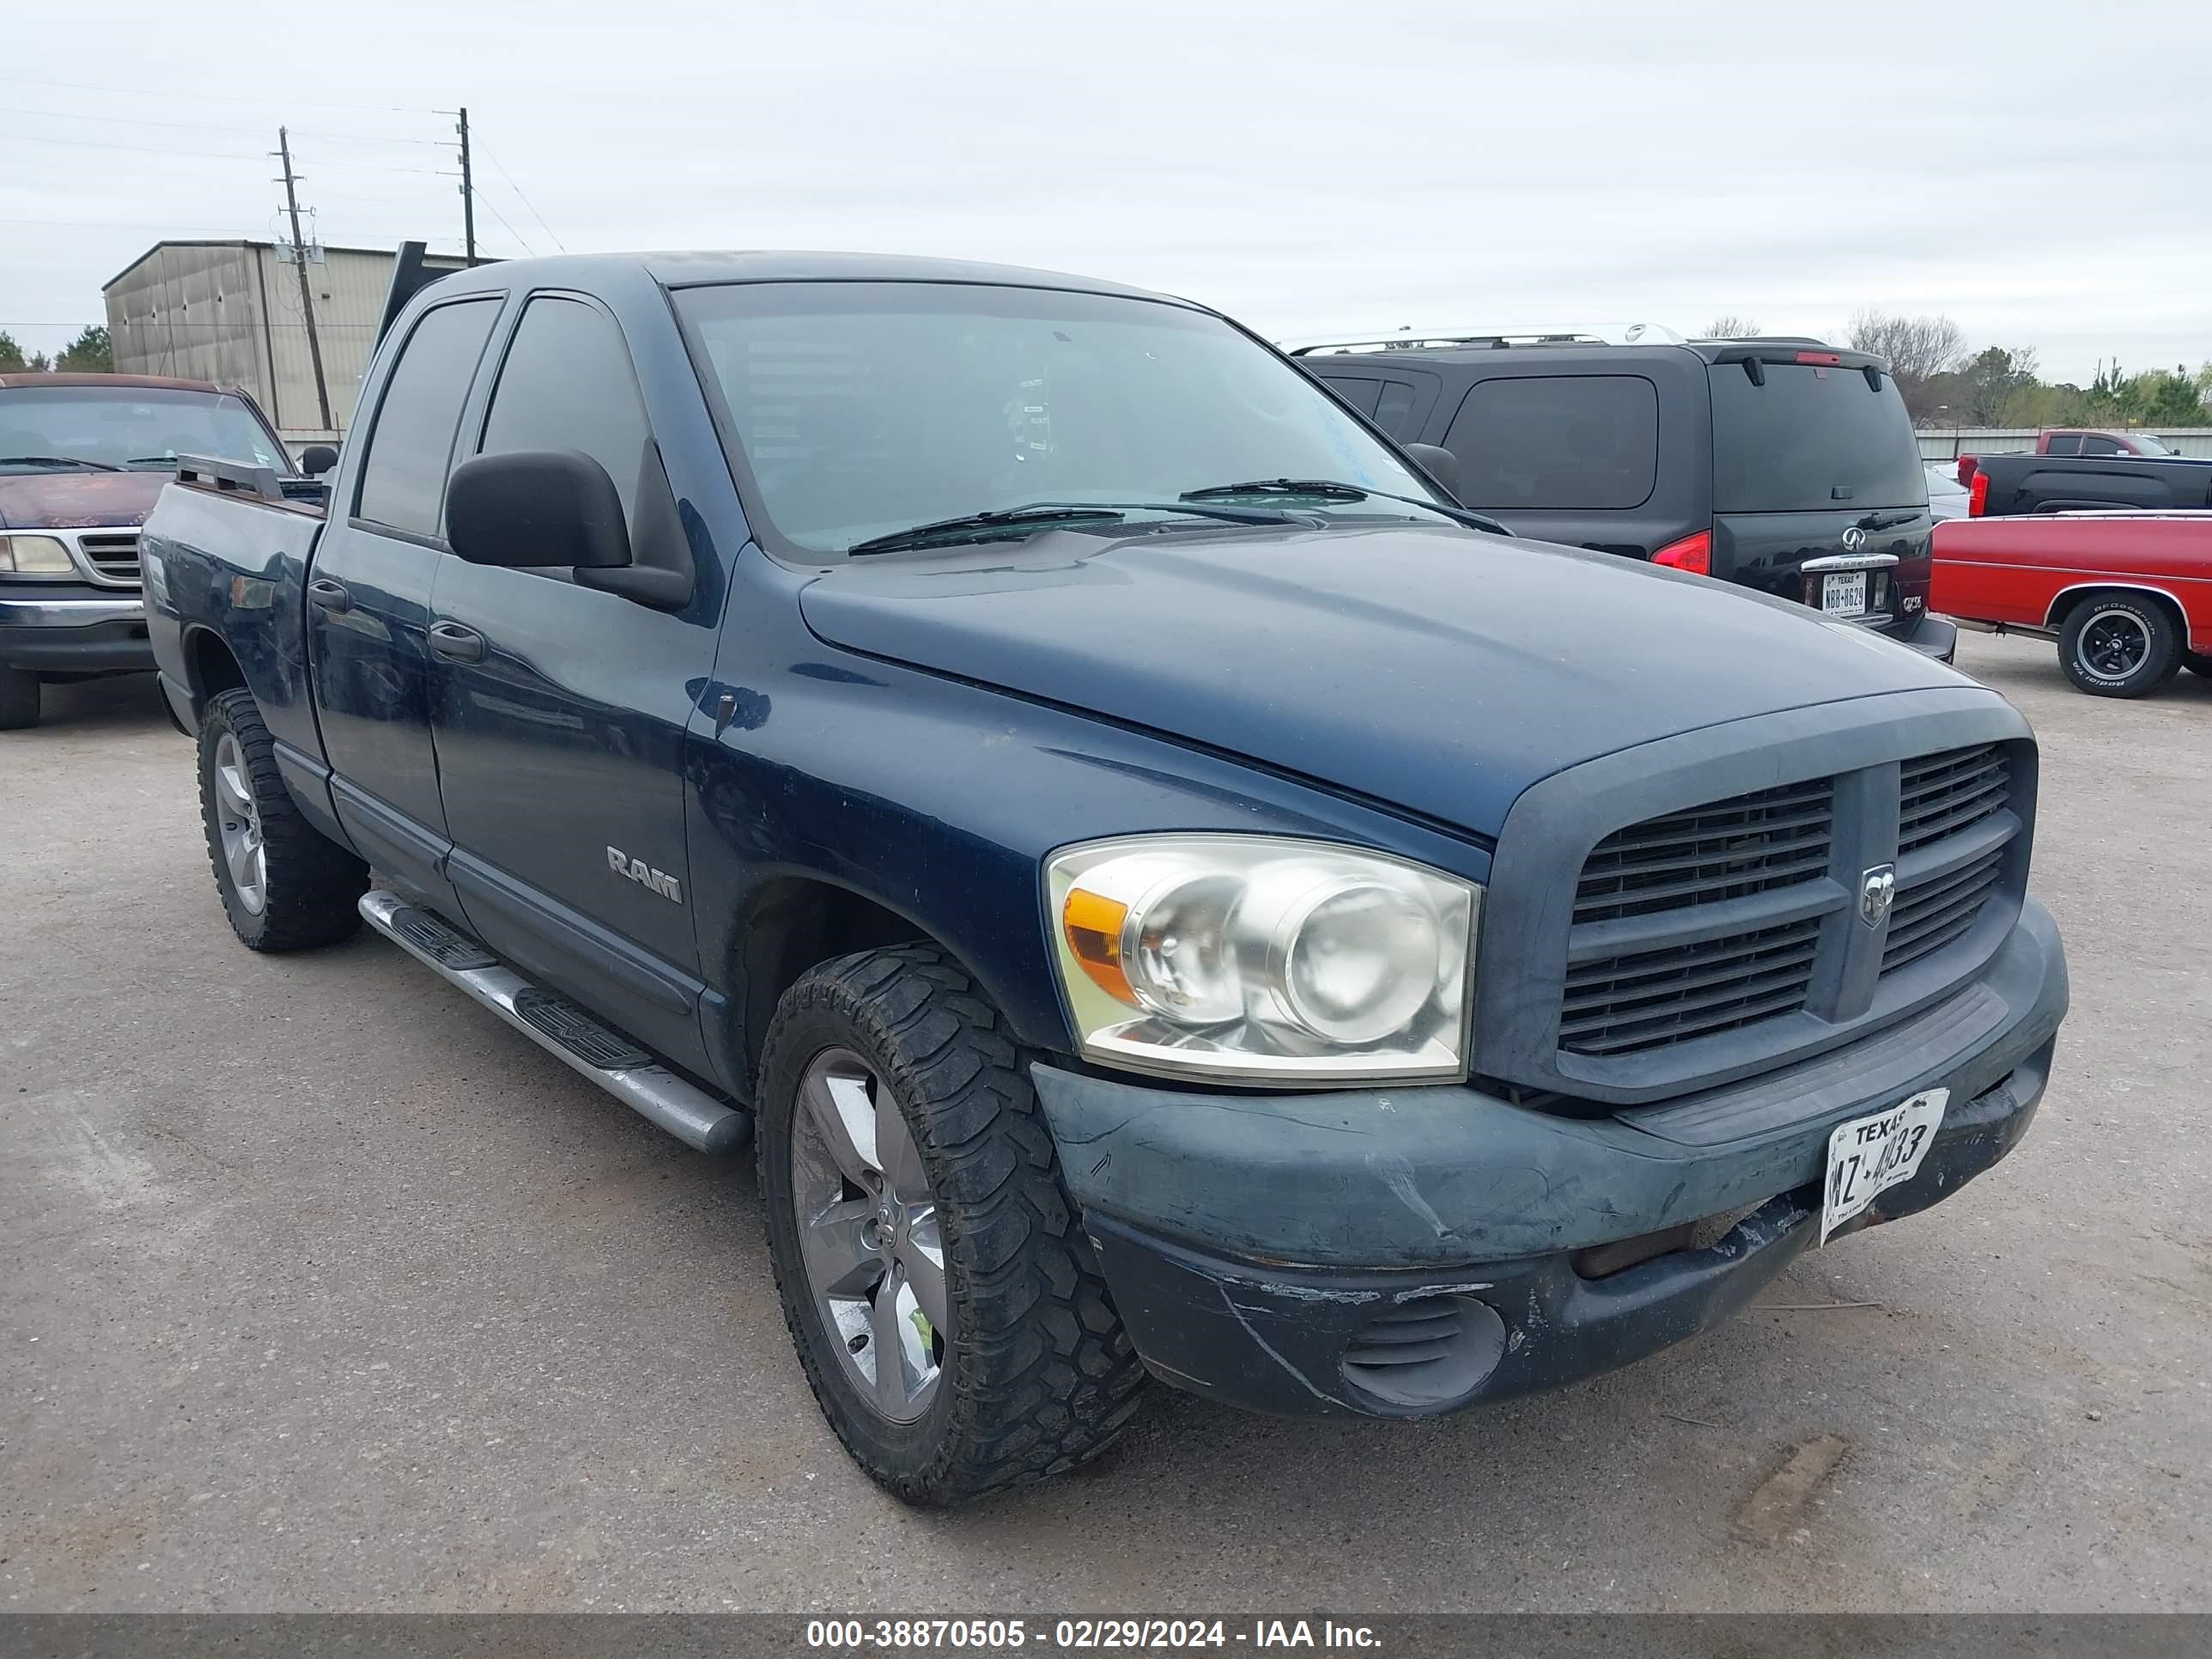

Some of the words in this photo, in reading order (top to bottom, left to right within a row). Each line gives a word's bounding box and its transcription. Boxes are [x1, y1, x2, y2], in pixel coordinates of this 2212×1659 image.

[1838, 575, 1854, 585] TEXAS
[2094, 603, 2156, 635] BFGoodrich
[606, 845, 684, 905] RAM
[1856, 1109, 1906, 1146] TEXAS
